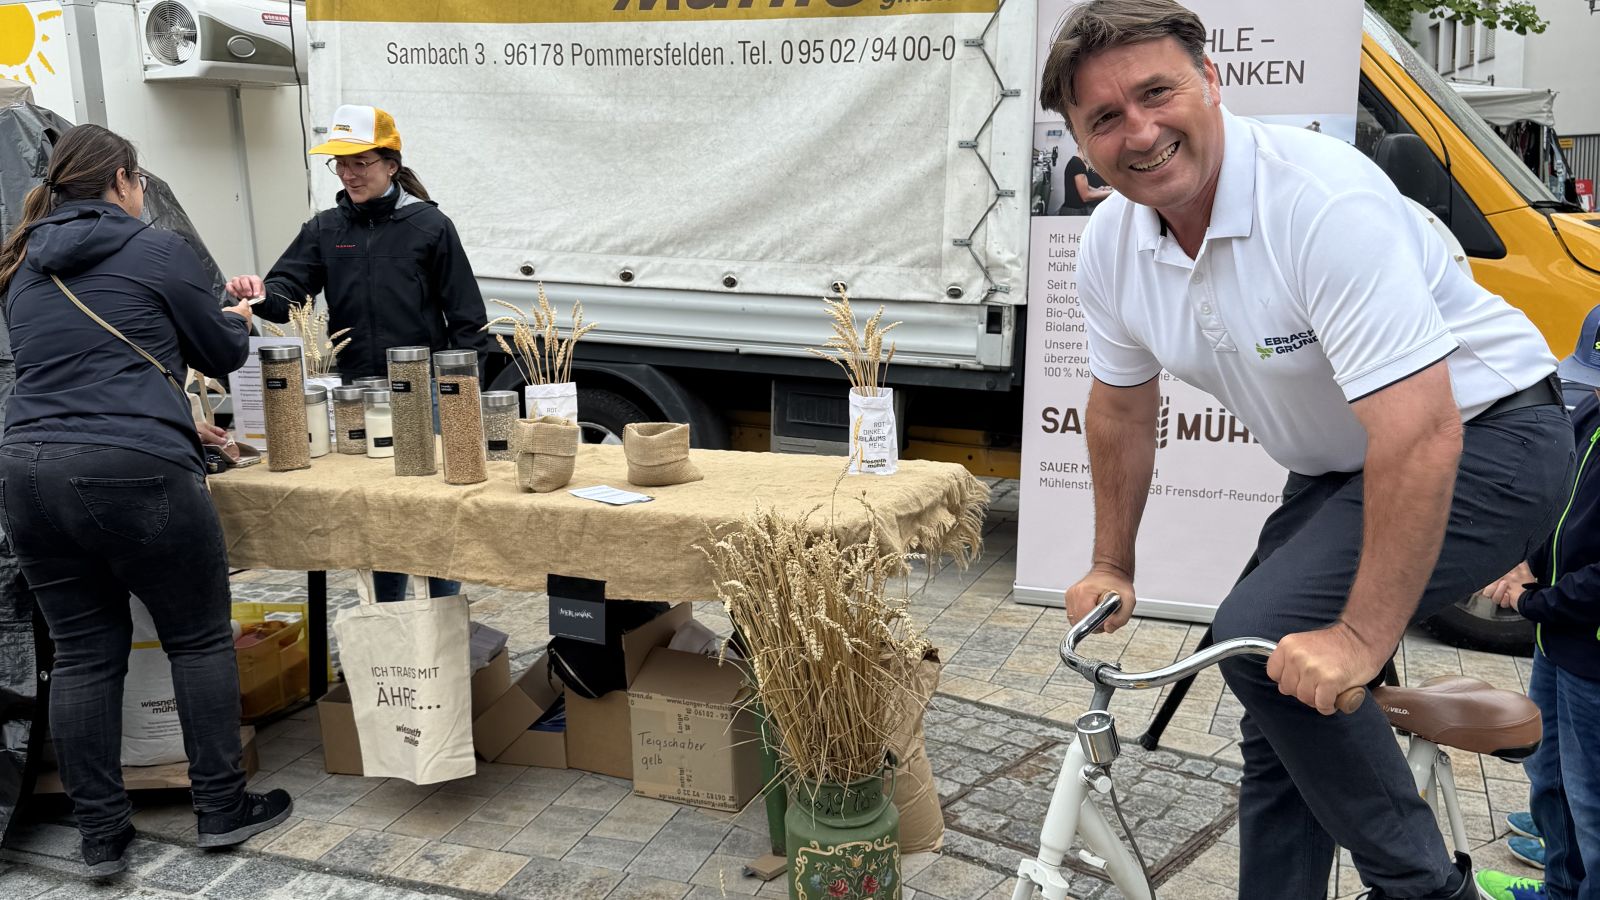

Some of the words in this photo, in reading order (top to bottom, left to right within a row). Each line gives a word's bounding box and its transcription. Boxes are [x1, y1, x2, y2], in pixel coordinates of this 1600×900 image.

[387, 42, 468, 65] Sambach
[475, 42, 485, 65] 3
[504, 43, 564, 66] 96178
[571, 41, 724, 67] Pommersfelden
[738, 40, 772, 65] Tel.
[1049, 233, 1065, 244] Mit
[1049, 248, 1076, 258] Luisa
[1047, 280, 1067, 290] Seit
[1044, 339, 1083, 350] Unsere
[1177, 407, 1262, 444] MÜH
[1040, 461, 1079, 473] SAUER
[371, 666, 388, 678] ICH
[418, 666, 440, 679] MIT
[637, 731, 707, 751] Teigschaber
[641, 755, 664, 770] gelb
